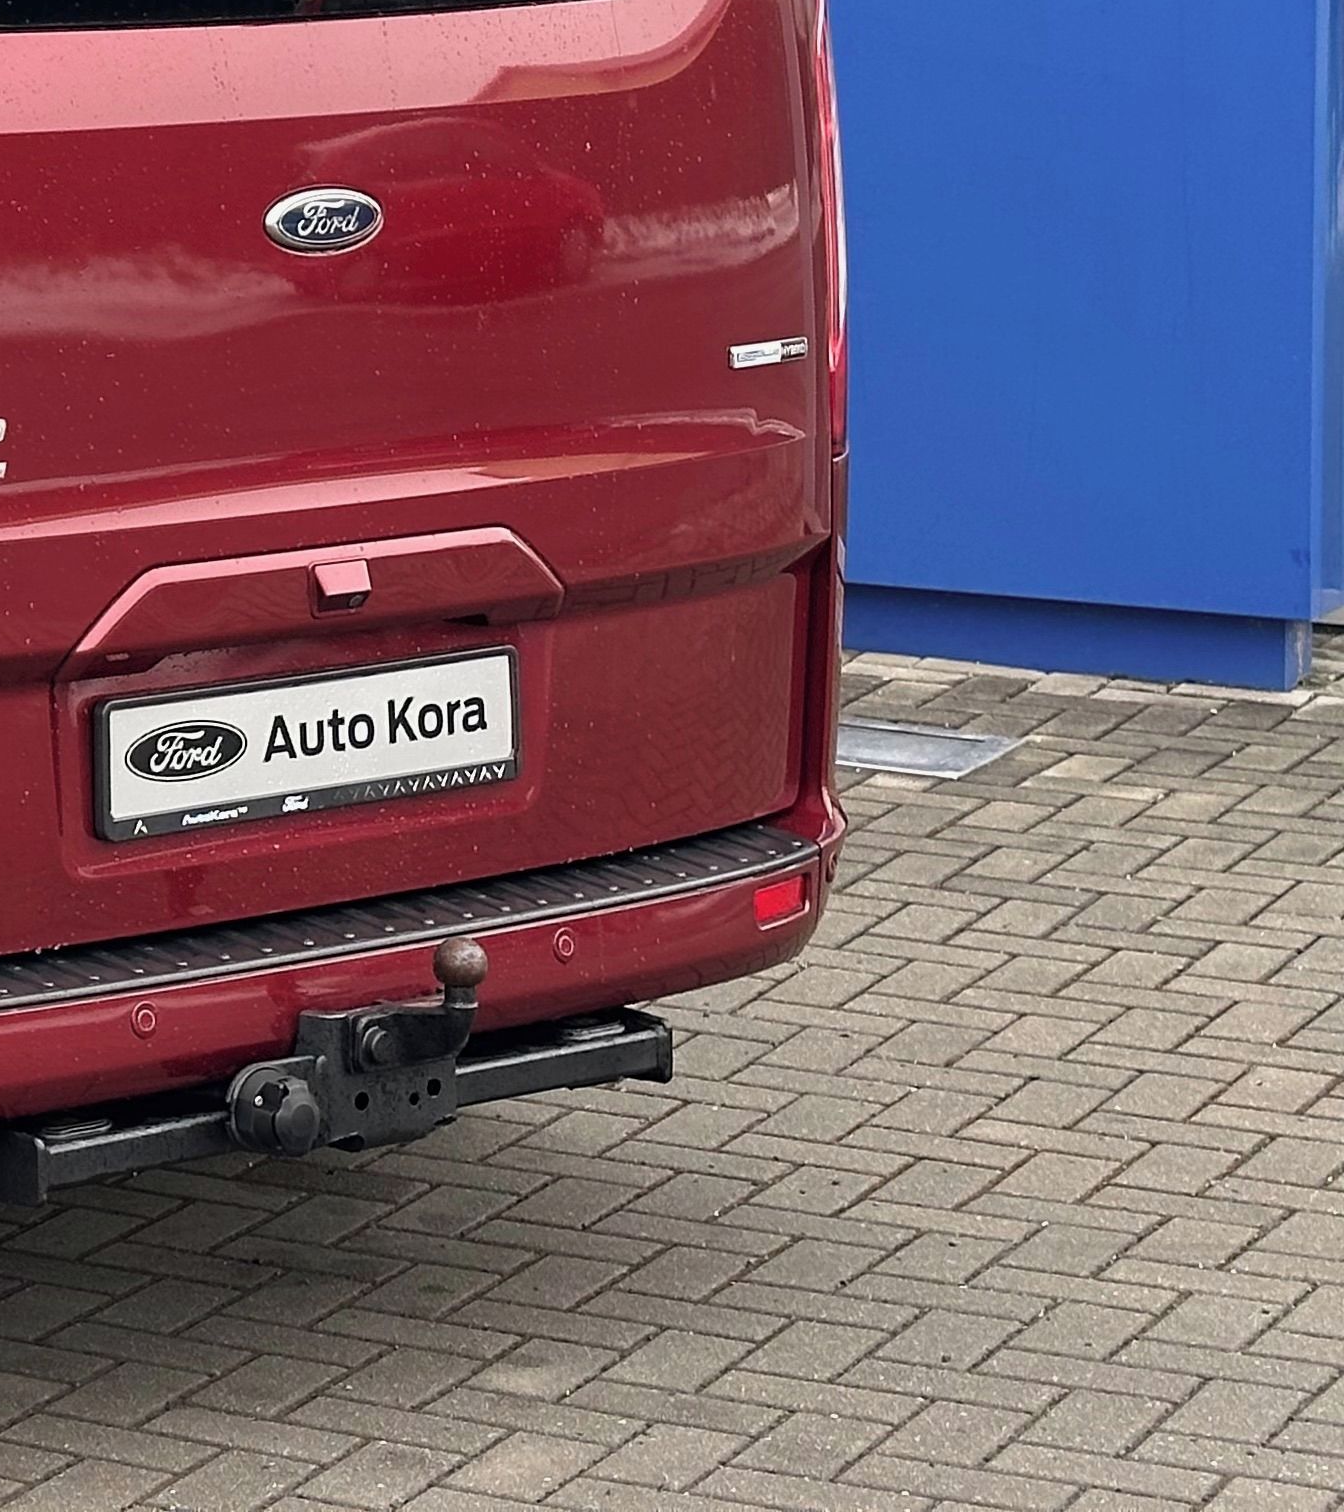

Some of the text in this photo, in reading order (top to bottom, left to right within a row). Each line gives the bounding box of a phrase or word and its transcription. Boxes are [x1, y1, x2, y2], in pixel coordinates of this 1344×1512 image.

[297, 199, 360, 236] Ford
[149, 695, 488, 773] Ford Auto Kora
